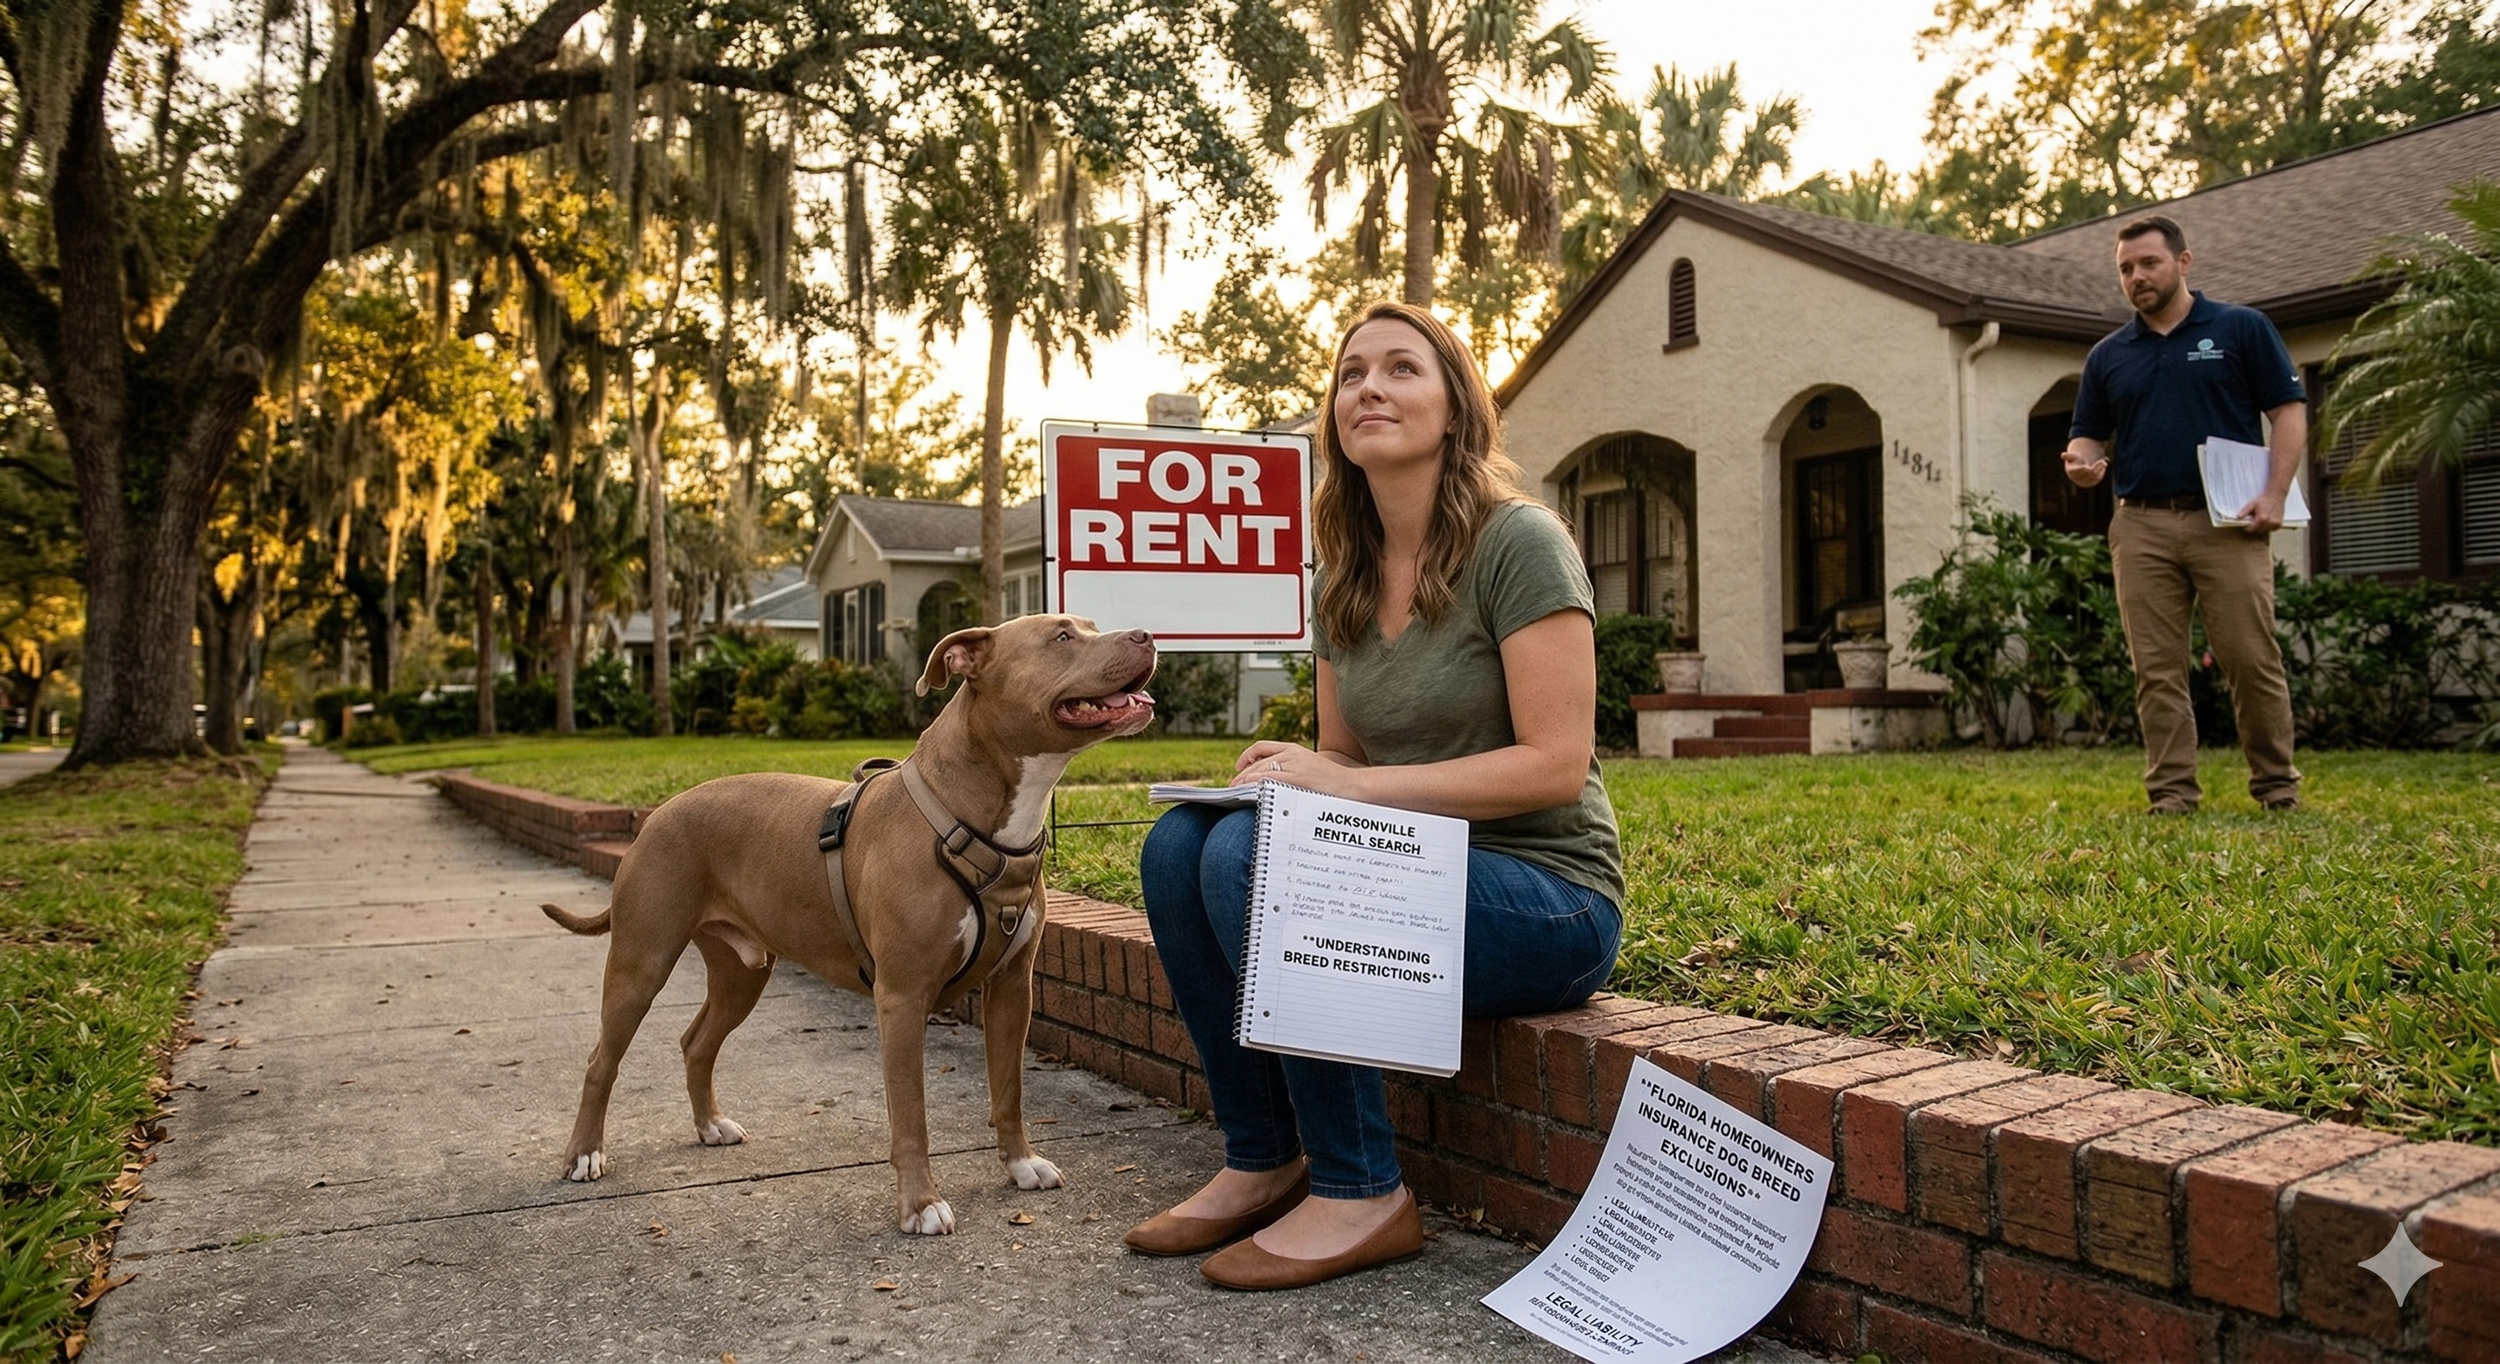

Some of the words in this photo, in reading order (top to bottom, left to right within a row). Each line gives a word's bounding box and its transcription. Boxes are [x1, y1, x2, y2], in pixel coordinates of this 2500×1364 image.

[1098, 447, 1263, 506] FOR
[1070, 508, 1291, 566] RENT
[1314, 827, 1365, 846] RENTAL
[1368, 836, 1421, 855] SEARCH
[1317, 811, 1416, 838] JACKSONVILLE
[1283, 950, 1329, 968] BREED
[1638, 1102, 1717, 1155] INSURANCE
[1717, 1146, 1748, 1174] DOG
[1751, 1165, 1801, 1202] BREED
[1710, 1116, 1815, 1184] HOMEOWNERS
[1545, 1291, 1584, 1319] LEGAL
[1582, 1313, 1644, 1348] LIABILITY
